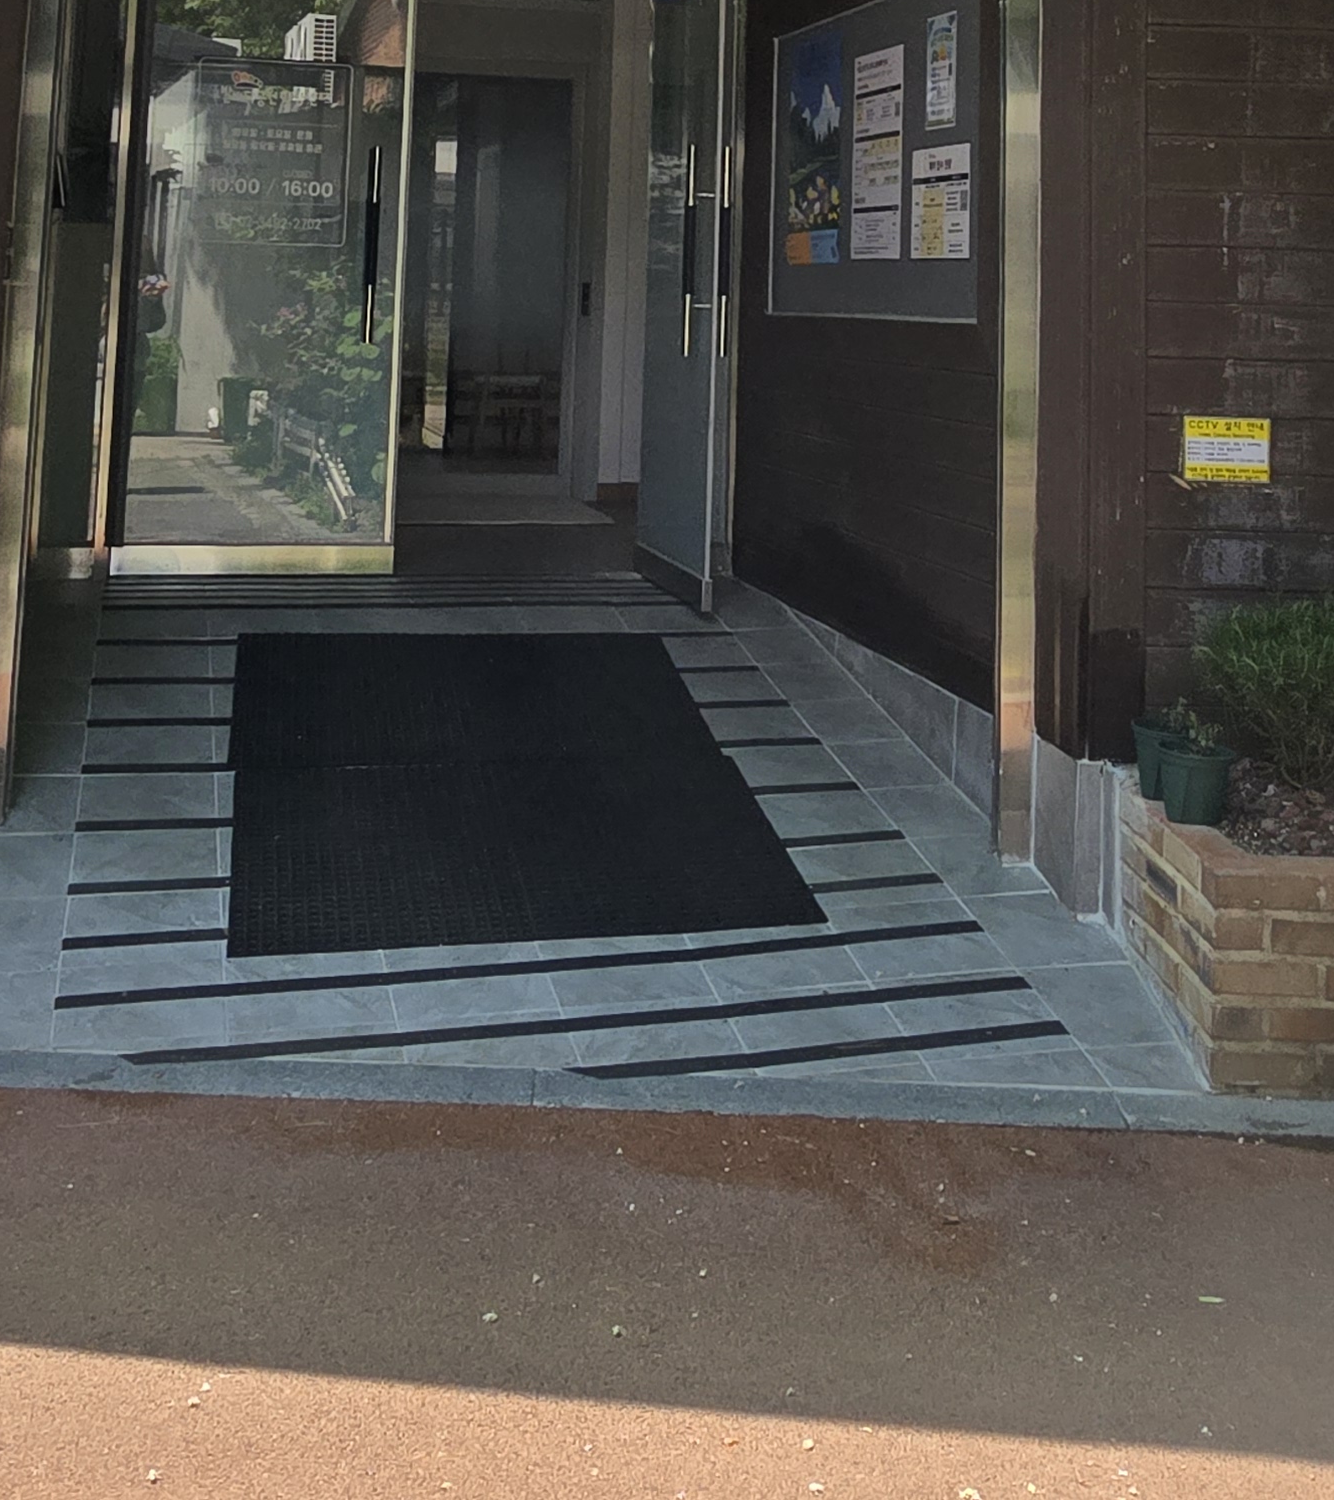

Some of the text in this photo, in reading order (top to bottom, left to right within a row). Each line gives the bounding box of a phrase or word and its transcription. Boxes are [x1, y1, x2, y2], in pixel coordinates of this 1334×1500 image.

[209, 178, 260, 195] 10:00
[281, 180, 333, 197] 16:00
[1188, 420, 1219, 429] CCTV
